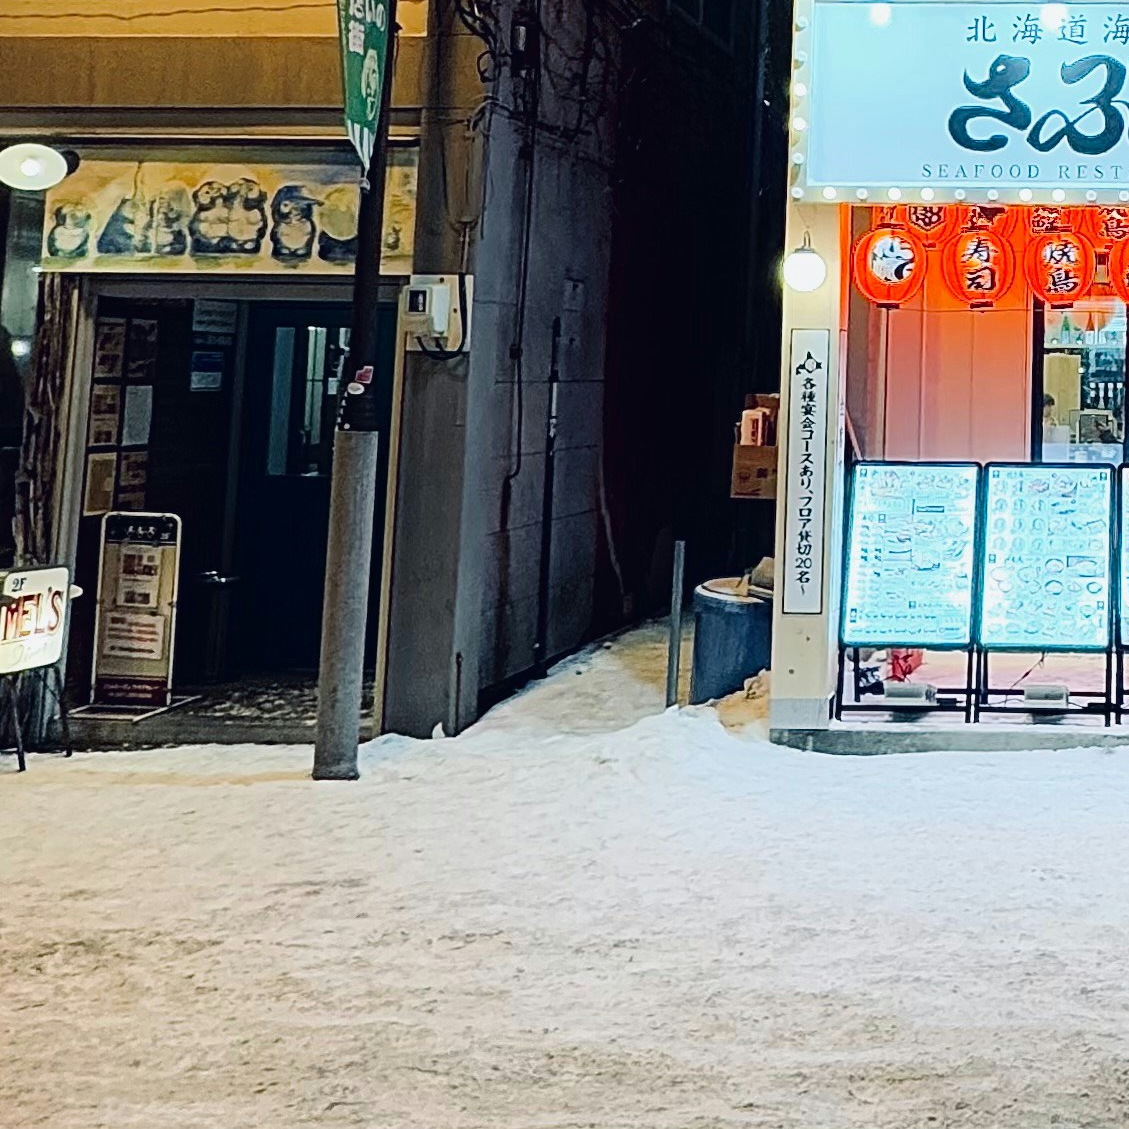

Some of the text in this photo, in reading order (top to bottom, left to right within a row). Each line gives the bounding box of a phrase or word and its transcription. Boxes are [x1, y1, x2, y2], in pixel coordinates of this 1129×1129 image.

[922, 164, 1041, 181] SEAFOOD
[963, 237, 996, 291] 寿司
[1043, 240, 1079, 293] 焼鳥
